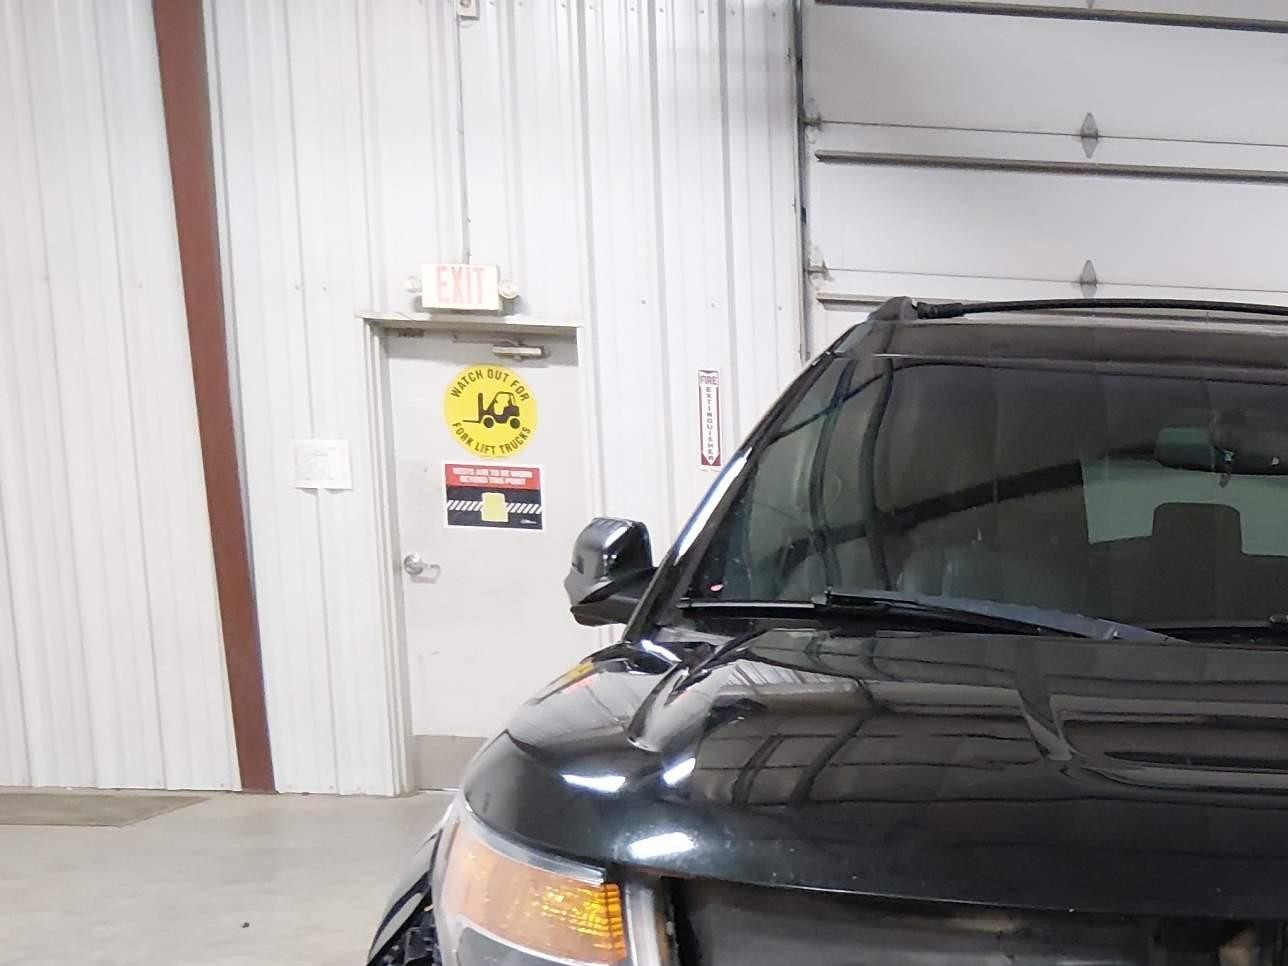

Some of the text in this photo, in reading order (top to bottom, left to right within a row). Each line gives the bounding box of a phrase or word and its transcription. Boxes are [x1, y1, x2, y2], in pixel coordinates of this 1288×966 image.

[436, 265, 485, 305] EXIT
[450, 368, 530, 402] WATCH OUT FOR
[700, 375, 718, 386] FIRE
[452, 421, 532, 456] FORK LIFT TRUCKS
[706, 386, 714, 460] EXTINGUISHER
